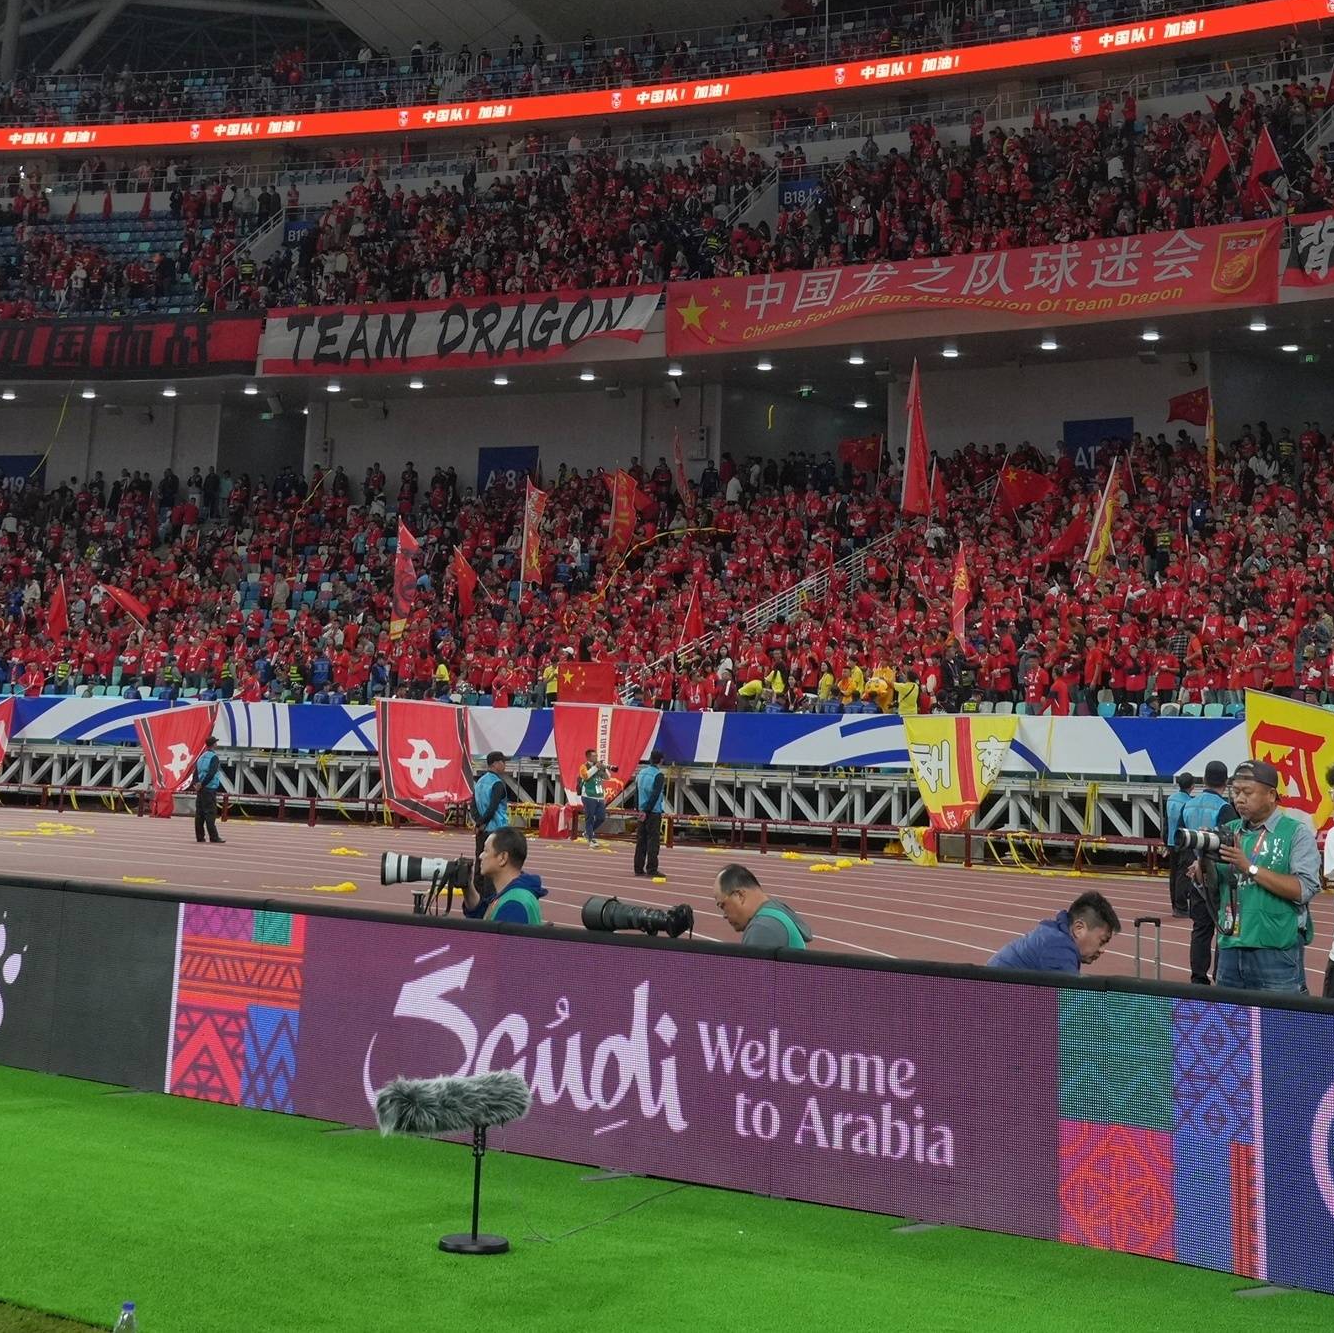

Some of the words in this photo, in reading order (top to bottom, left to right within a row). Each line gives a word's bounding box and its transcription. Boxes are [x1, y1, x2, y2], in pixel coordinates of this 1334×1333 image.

[783, 190, 807, 205] B18
[745, 230, 1204, 319] 中国龙之队球迷会
[286, 308, 417, 366] TEAM
[437, 292, 635, 360] DRAGON
[742, 318, 802, 340] Chinese
[803, 297, 868, 329] Football
[869, 293, 911, 307] Fans
[915, 294, 1031, 312] Association
[1036, 298, 1061, 313] Of
[1065, 296, 1113, 312] Team
[1116, 285, 1183, 309] Dragon
[364, 945, 688, 1136] Saudi
[697, 1021, 917, 1099] Welcome
[734, 1092, 781, 1140] to
[793, 1095, 954, 1167] Arabia
